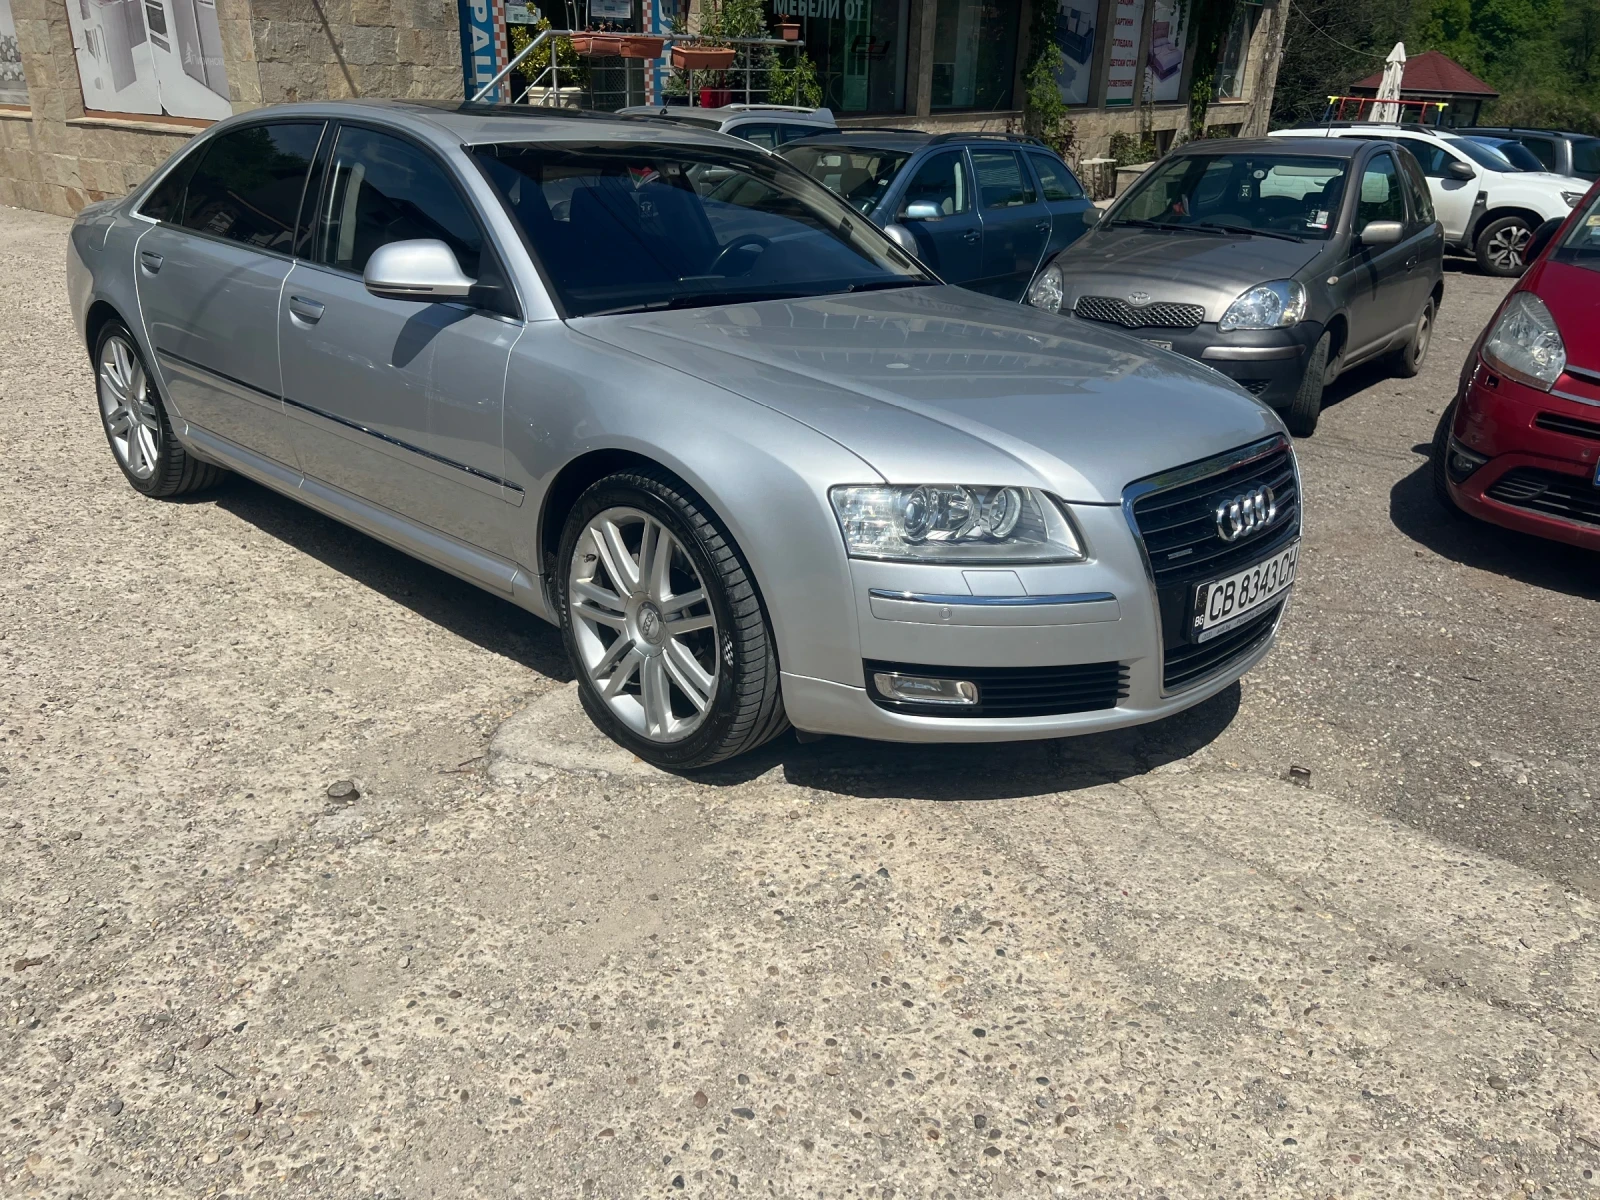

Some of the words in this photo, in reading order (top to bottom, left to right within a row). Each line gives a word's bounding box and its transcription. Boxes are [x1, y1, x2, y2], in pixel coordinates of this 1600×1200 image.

[773, 0, 840, 19] МЕБЕЛИ
[1209, 580, 1236, 621] CB
[1238, 559, 1278, 609] 8343
[1278, 547, 1298, 587] CH
[1194, 614, 1204, 627] BG
